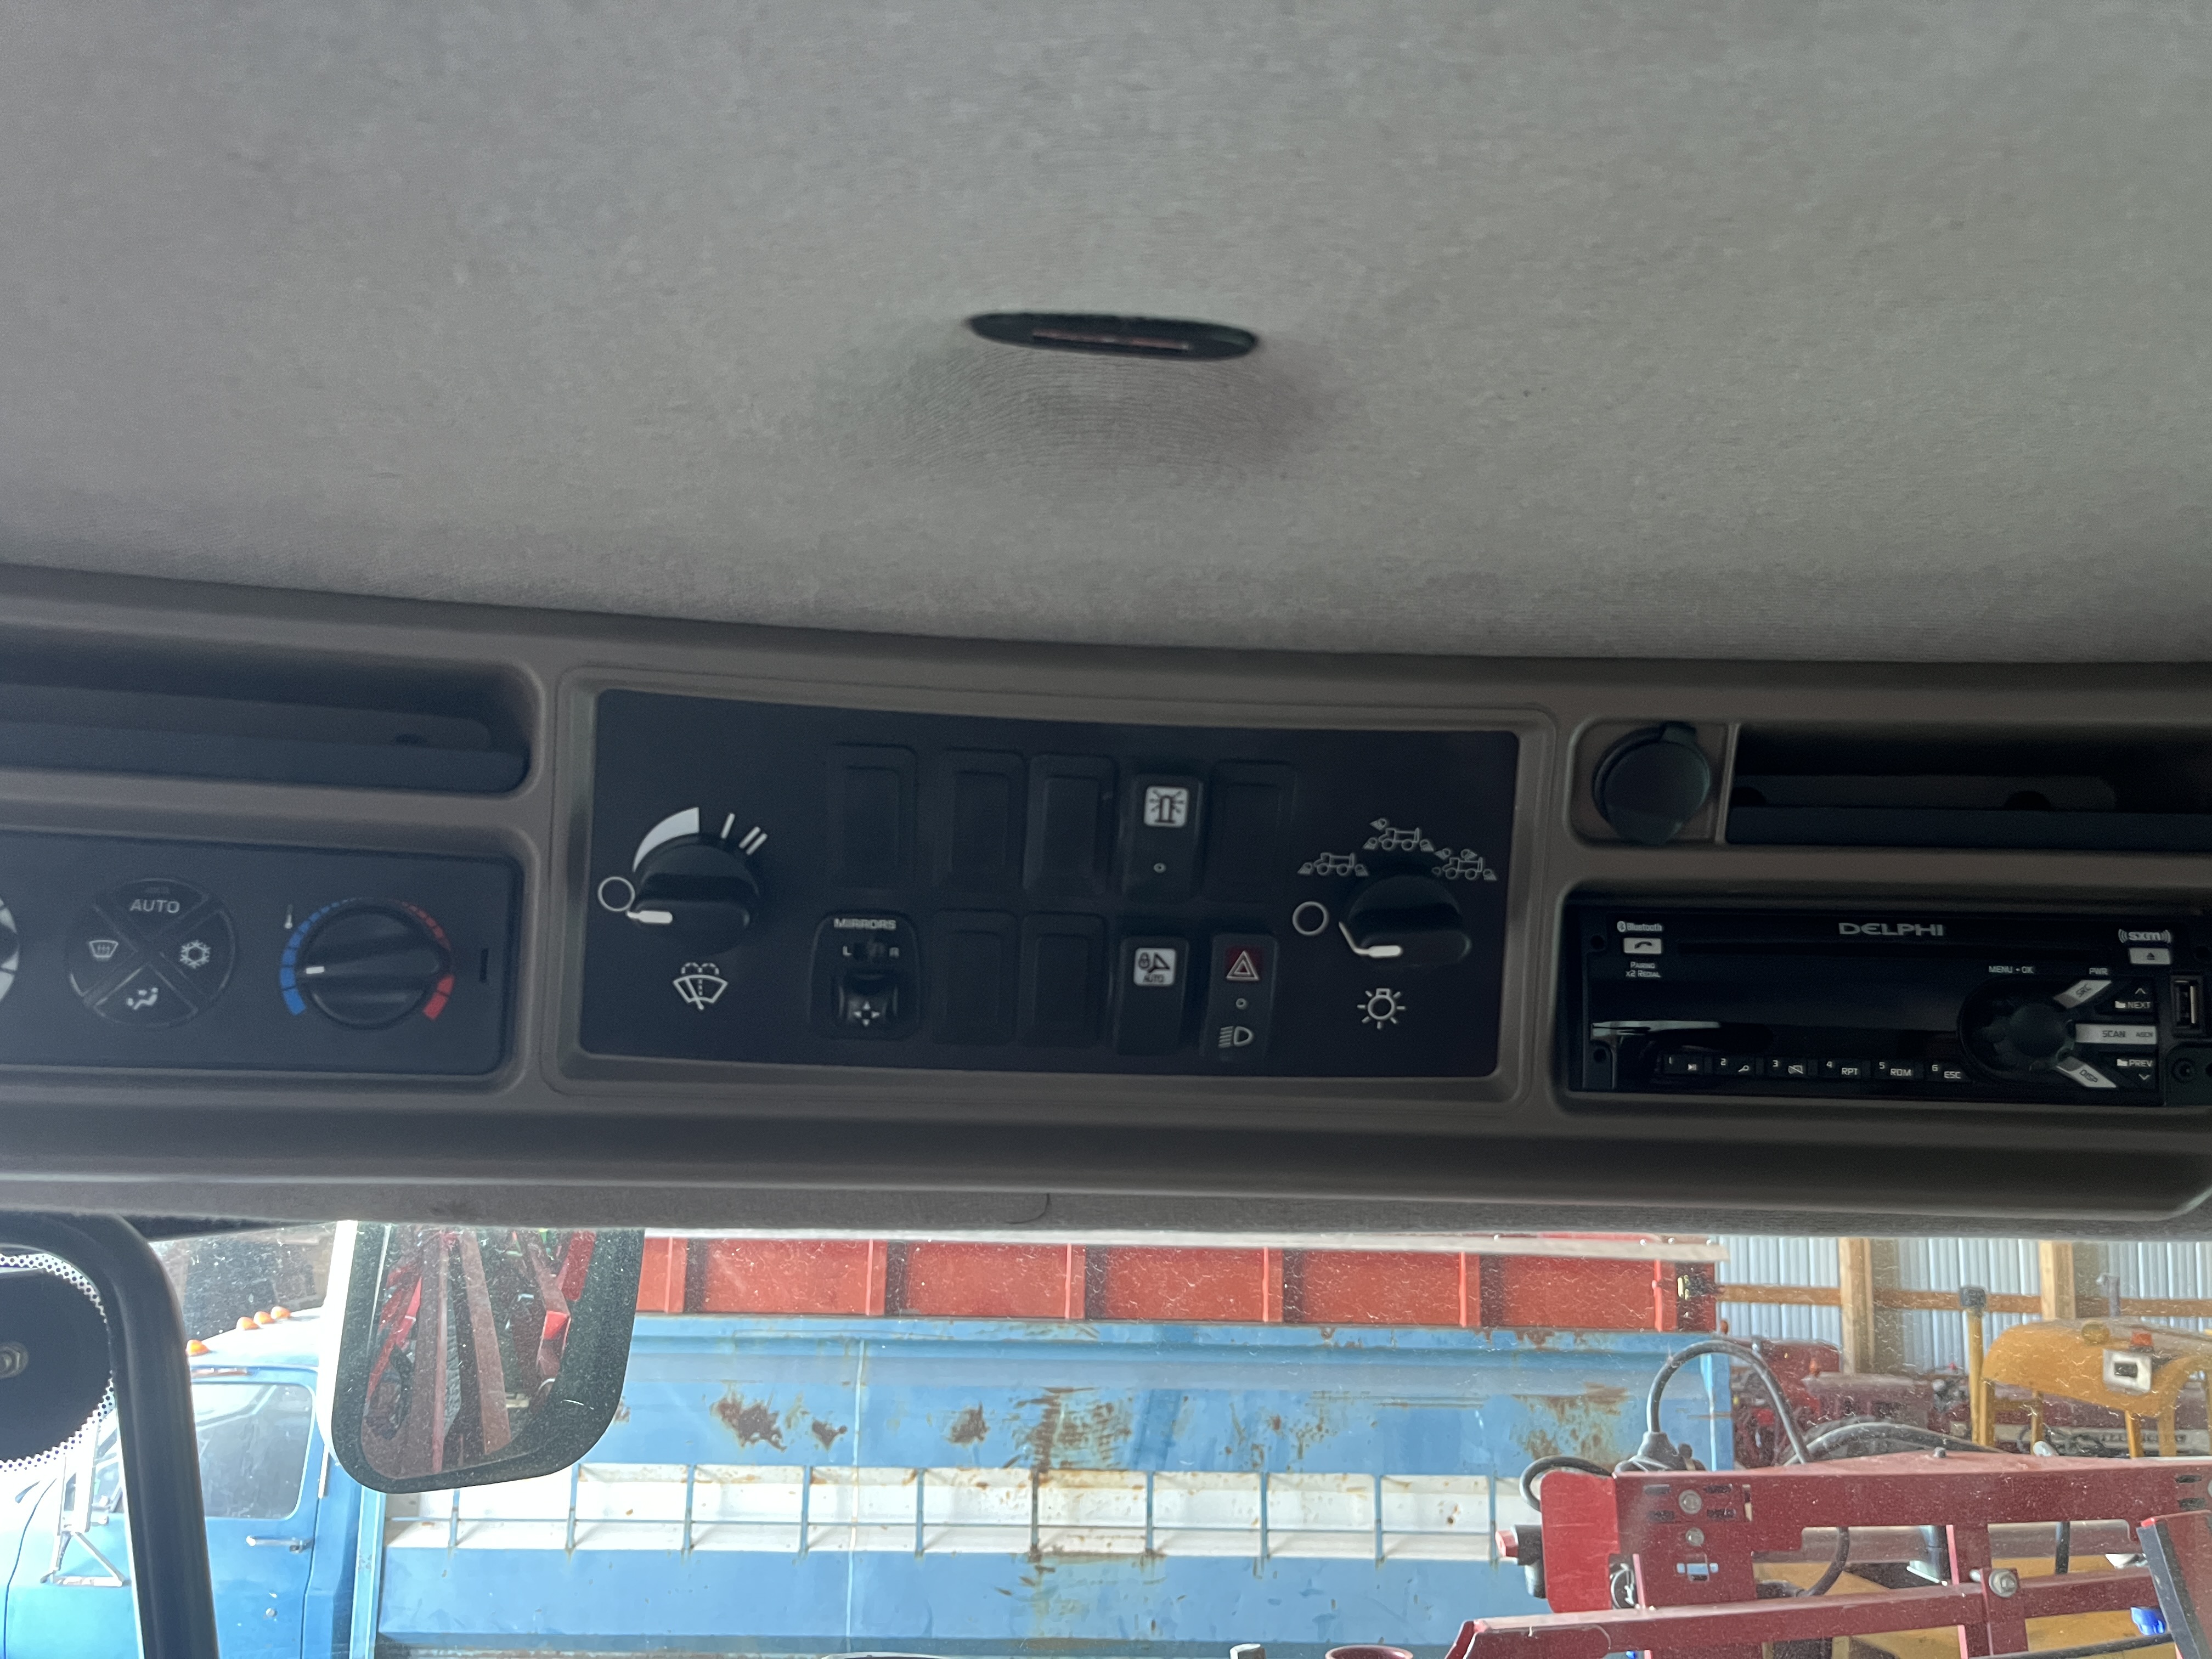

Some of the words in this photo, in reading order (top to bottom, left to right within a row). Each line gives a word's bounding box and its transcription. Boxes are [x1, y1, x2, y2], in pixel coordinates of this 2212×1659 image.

[130, 899, 180, 913] AUTO
[834, 918, 896, 930] MIRRORS
[1626, 923, 1663, 931] Bluetooth
[1838, 922, 1943, 936] DELPHI
[843, 946, 851, 956] L
[2076, 984, 2092, 997] SRC
[1944, 1071, 1962, 1079] ESC
[2079, 1069, 2098, 1082] DISP
